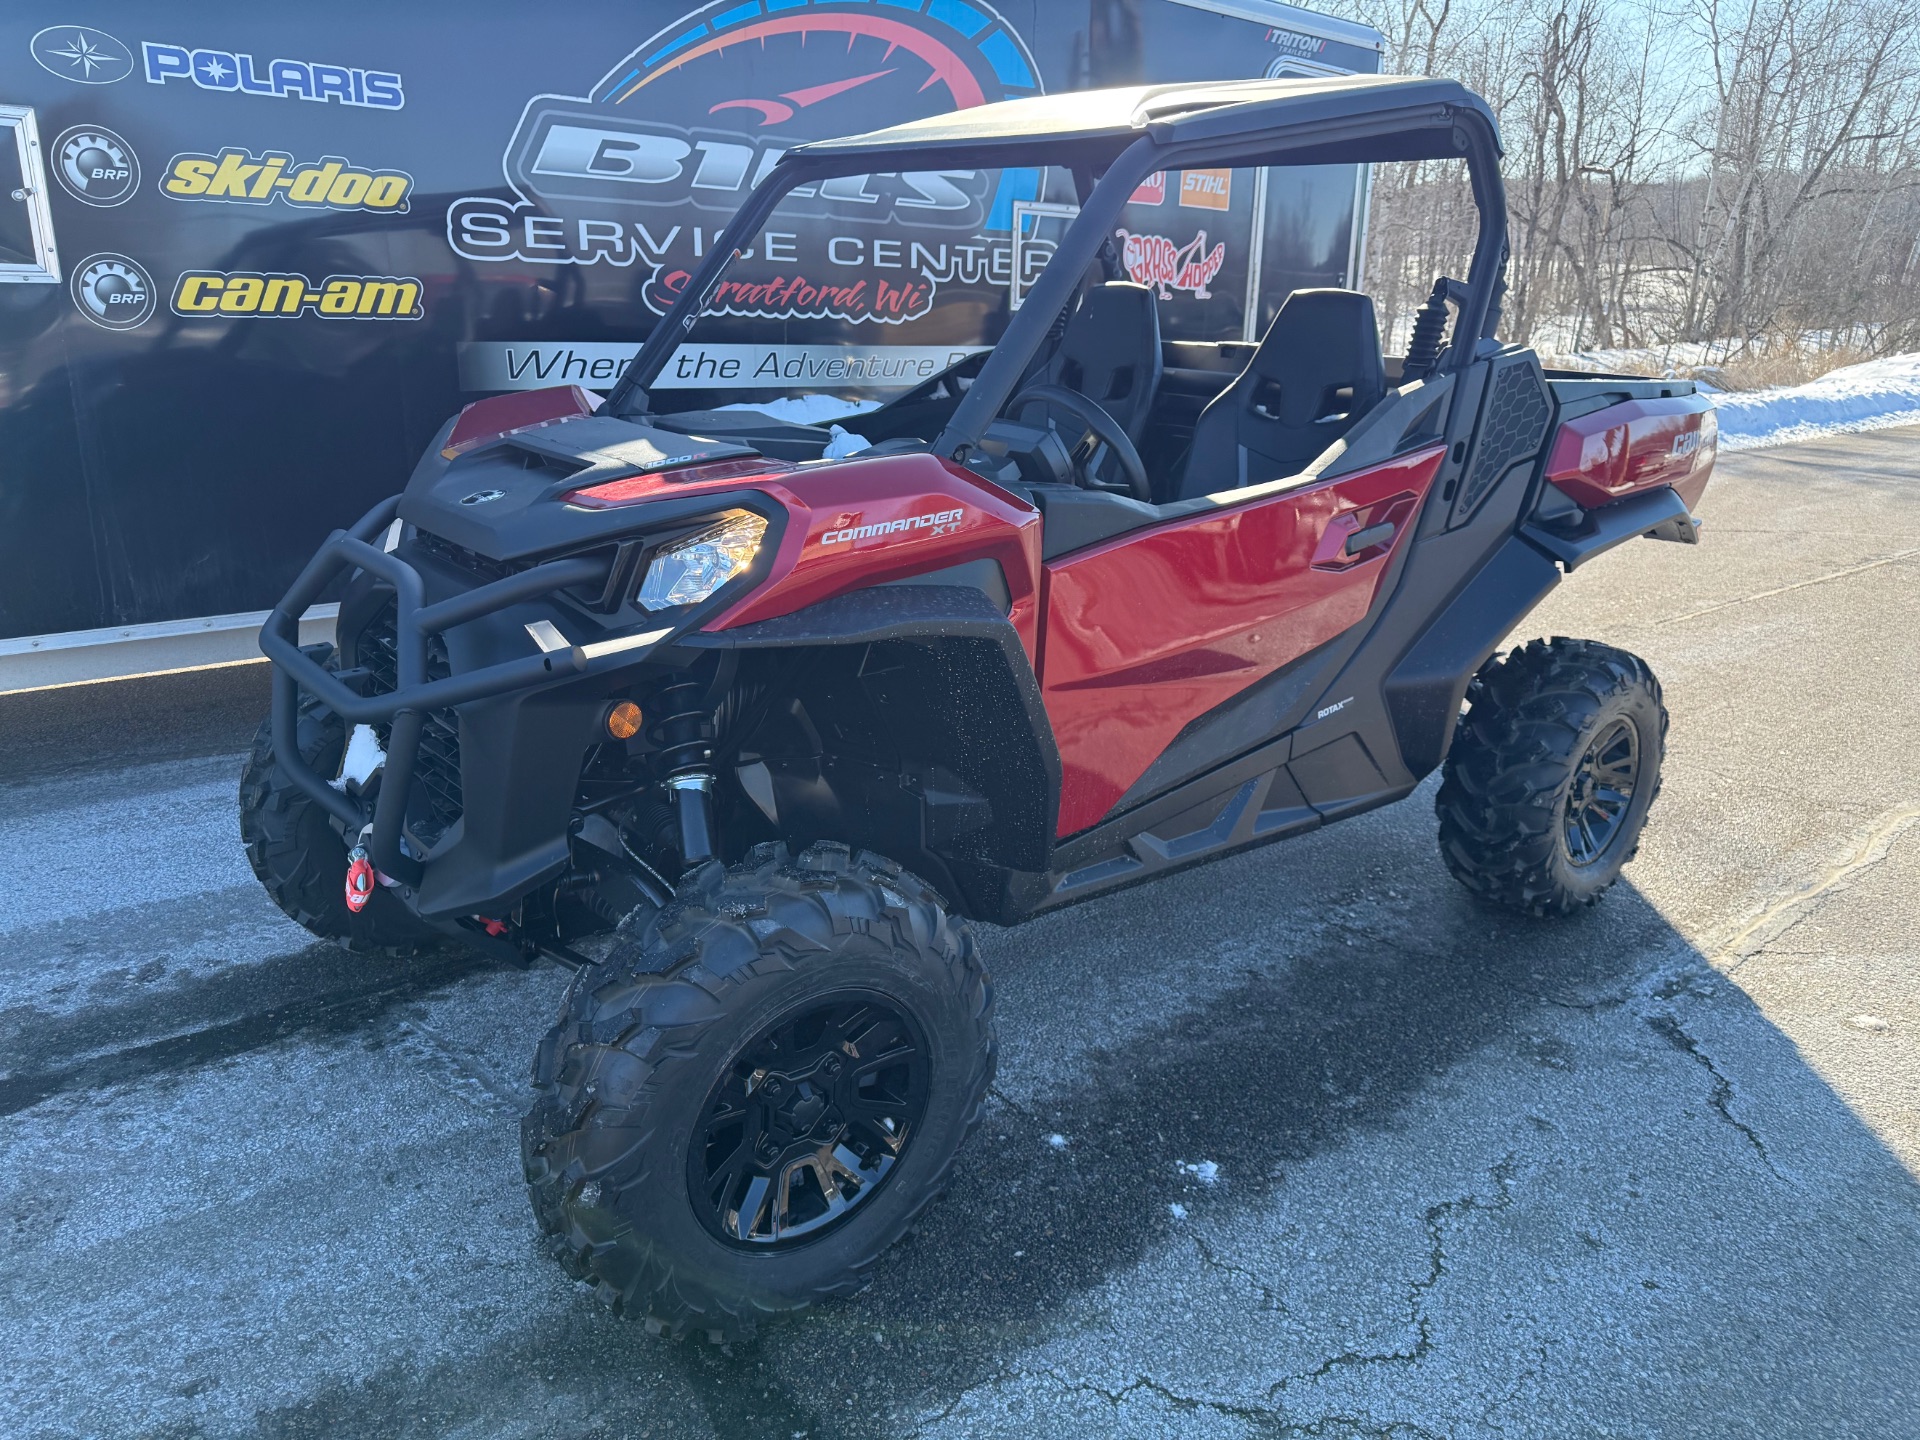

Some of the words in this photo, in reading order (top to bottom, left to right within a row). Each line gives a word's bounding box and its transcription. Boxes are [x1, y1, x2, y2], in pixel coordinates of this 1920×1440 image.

[1271, 29, 1322, 52] TRITON
[1279, 45, 1312, 58] TRAILERS
[142, 41, 404, 110] POLARIS
[91, 168, 129, 181] BRP
[166, 154, 409, 208] ski-doo
[1183, 173, 1227, 195] STIHL
[460, 212, 798, 263] SERVIE
[109, 293, 145, 304] BRP
[176, 276, 421, 314] can-am
[662, 269, 862, 313] Sratford,
[506, 349, 633, 380] Wher
[676, 351, 741, 379] the
[753, 351, 934, 380] Adventure
[821, 508, 964, 545] COMMANDER
[930, 521, 960, 536] XT
[1317, 701, 1344, 719] ROTAX
